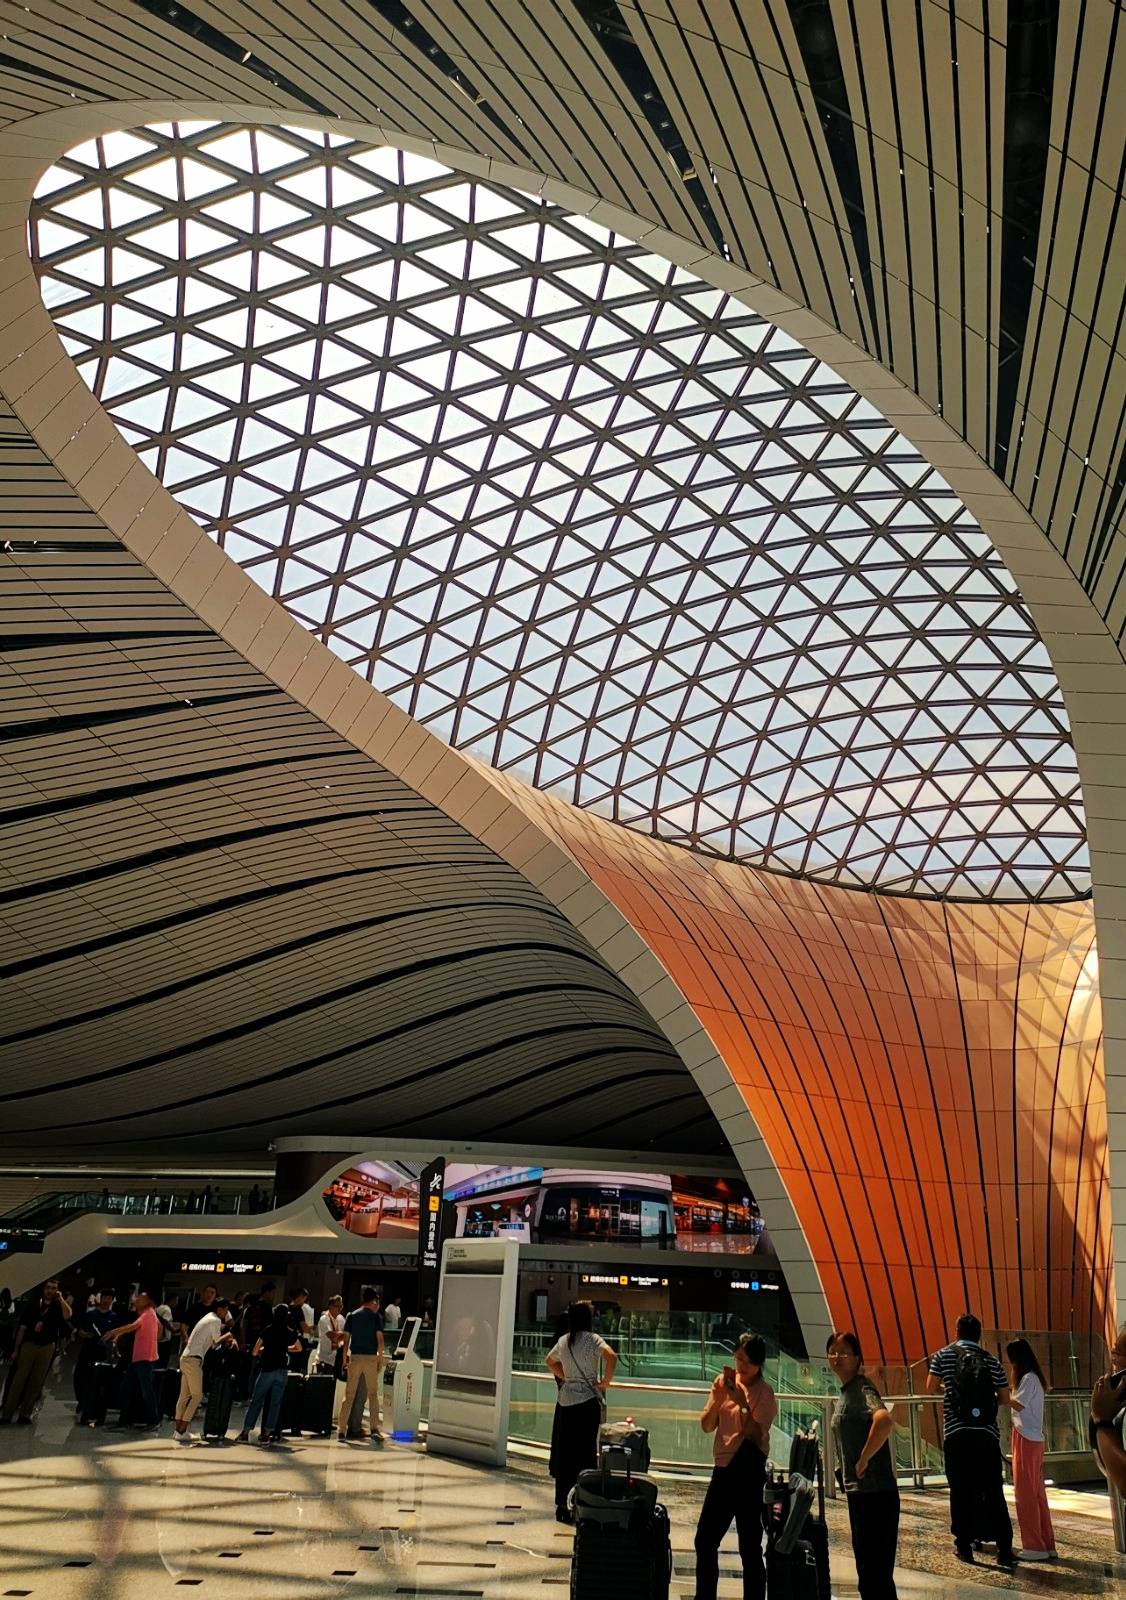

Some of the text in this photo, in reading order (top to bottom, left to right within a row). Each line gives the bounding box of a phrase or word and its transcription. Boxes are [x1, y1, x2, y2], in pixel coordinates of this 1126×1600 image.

[428, 1212, 437, 1251] 国内登机
[423, 1258, 437, 1268] Boarding
